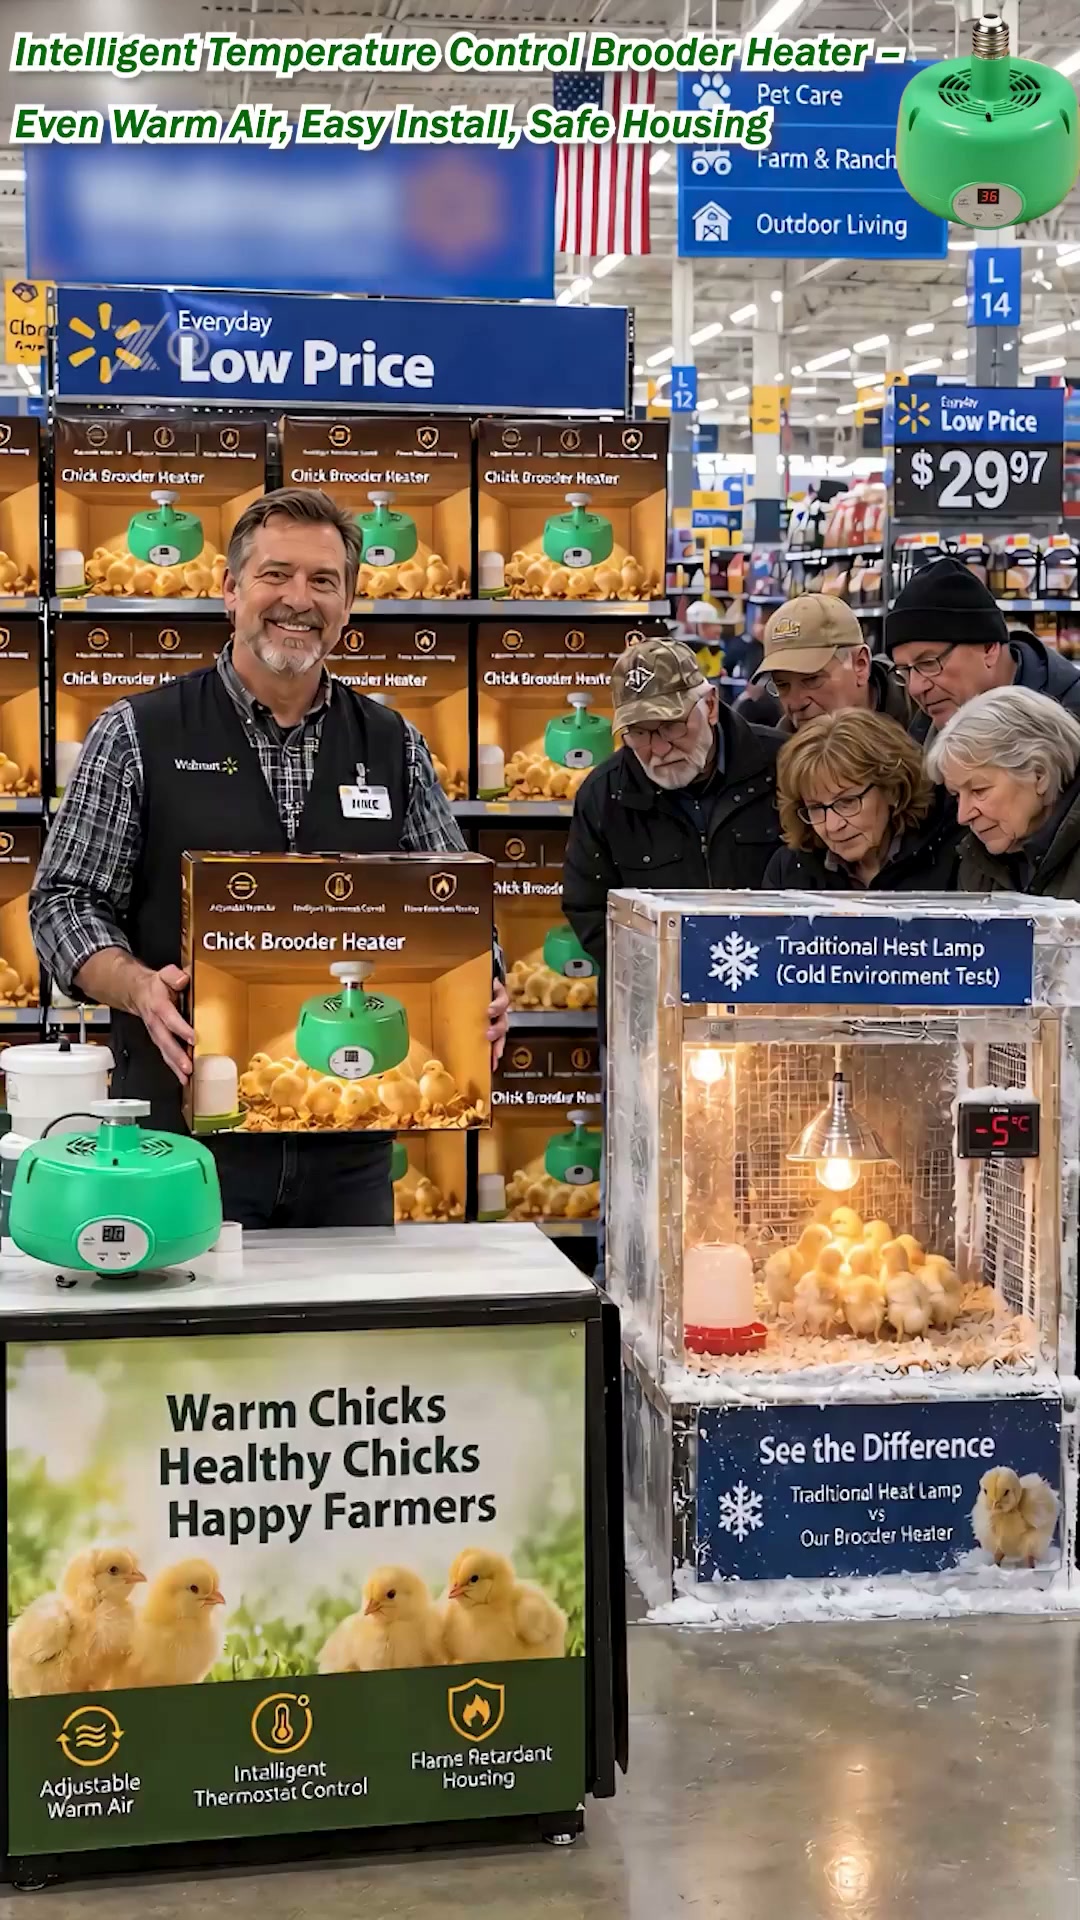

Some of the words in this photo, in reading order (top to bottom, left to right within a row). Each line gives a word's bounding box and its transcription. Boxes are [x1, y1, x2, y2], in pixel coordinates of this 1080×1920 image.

[757, 83, 791, 105] Pet
[796, 84, 843, 106] Care
[757, 149, 809, 169] Farm
[814, 148, 830, 170] &
[836, 148, 897, 170] Ranch
[981, 190, 998, 202] 36
[756, 212, 842, 234] Outdoor
[847, 213, 908, 240] Living
[988, 257, 1004, 284] L
[981, 291, 1012, 318] 14
[178, 309, 273, 338] Everyday
[179, 336, 292, 384] Low
[303, 340, 436, 388] Price
[678, 371, 689, 388] L
[673, 390, 694, 409] 12
[941, 409, 984, 432] Low
[988, 408, 1038, 433] Price
[203, 931, 256, 950] Chick
[260, 931, 338, 951] Brooder
[342, 932, 406, 951] Heater
[775, 936, 878, 956] Traditional
[933, 937, 985, 961] Lamp
[776, 964, 826, 986] (Cold
[831, 965, 950, 986] Environment
[955, 966, 1000, 988] Test)
[166, 1393, 297, 1432] Warm
[309, 1385, 447, 1427] Chicks
[759, 1436, 806, 1465] See
[813, 1433, 856, 1463] the
[863, 1430, 996, 1462] Difference
[160, 1442, 332, 1489] Healthy
[343, 1435, 481, 1478] Chicks
[878, 1481, 915, 1501] Heat
[919, 1481, 963, 1504] Lamp
[169, 1497, 312, 1545] Happy
[324, 1491, 497, 1530] Farmers
[801, 1528, 830, 1547] Our
[39, 1772, 141, 1800] Adjustable
[301, 1776, 368, 1800] Control
[47, 1801, 102, 1819] Warm
[107, 1796, 134, 1816] Air
